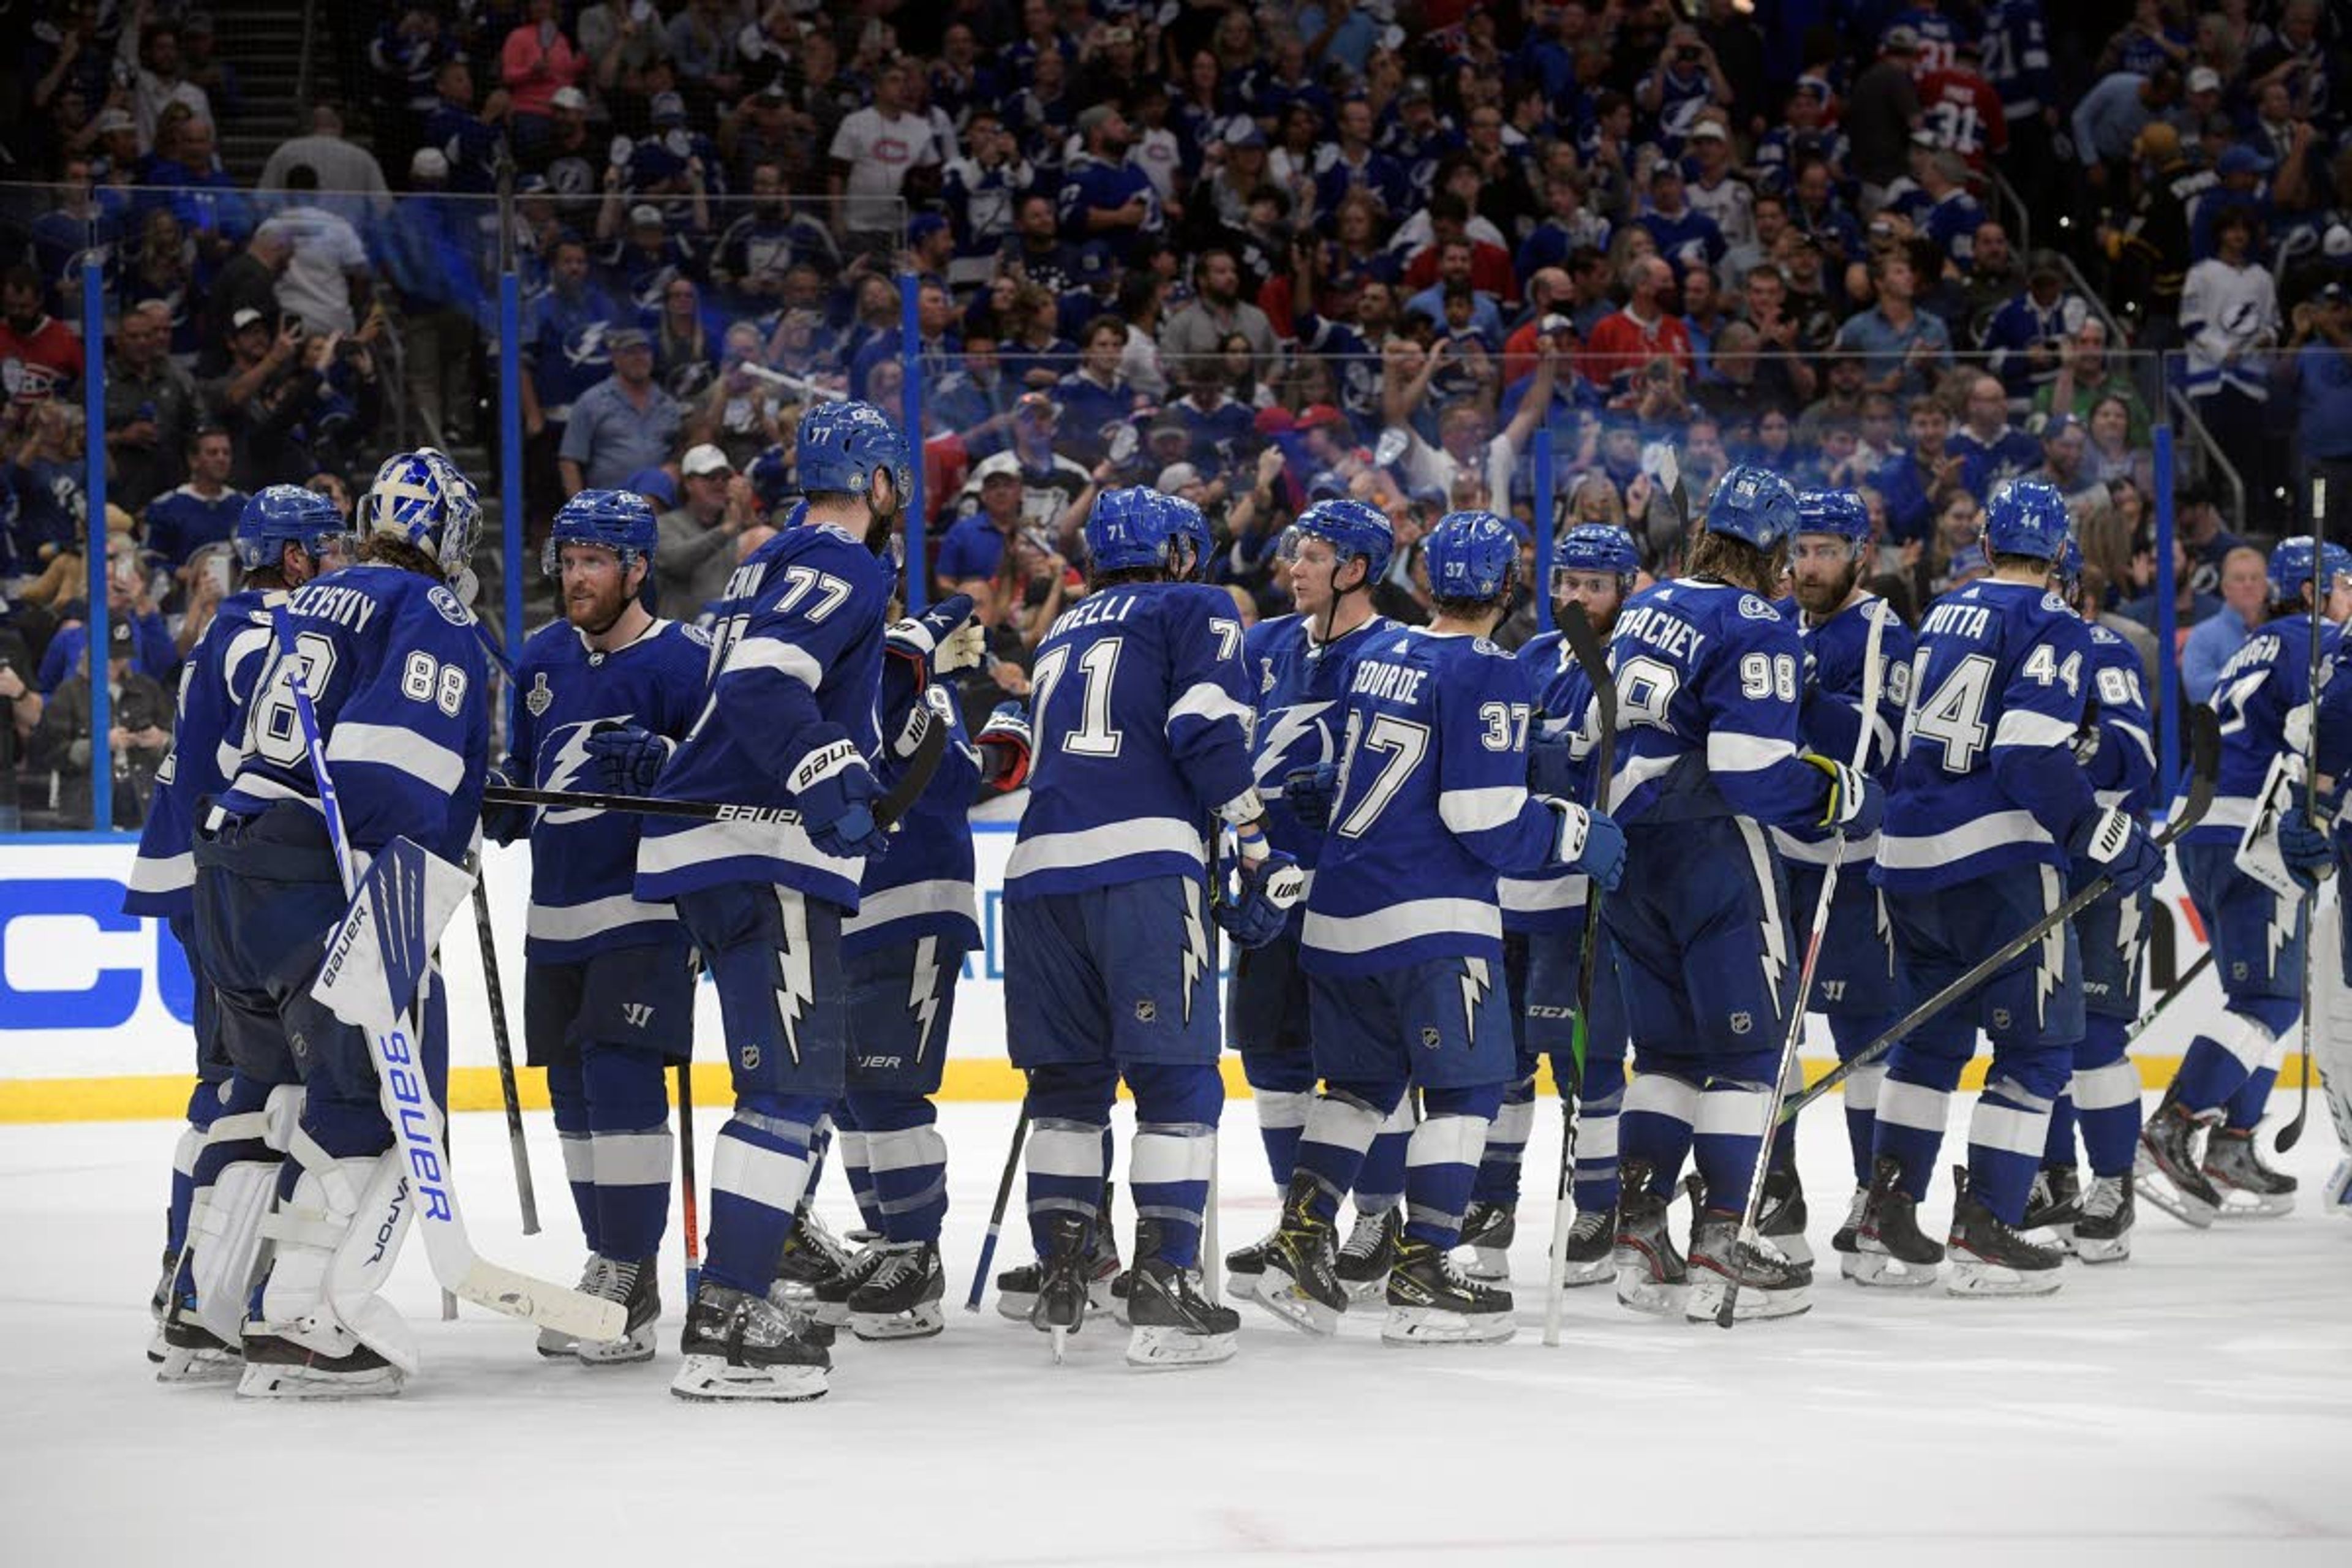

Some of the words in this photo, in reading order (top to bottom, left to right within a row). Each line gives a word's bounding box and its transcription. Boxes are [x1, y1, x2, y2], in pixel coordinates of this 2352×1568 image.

[812, 427, 832, 446] 77
[1107, 523, 1126, 541] 71
[2021, 513, 2041, 528] 44
[772, 565, 854, 624] 77
[1445, 562, 1466, 578] 37
[1208, 617, 1247, 662] 7
[402, 650, 468, 718] 88
[1740, 652, 1796, 703] 98
[2022, 644, 2083, 697] 44
[1028, 637, 1124, 781] 71
[1479, 702, 1531, 753] 37
[715, 804, 802, 826] BAUE
[380, 1030, 453, 1223] BAUER
